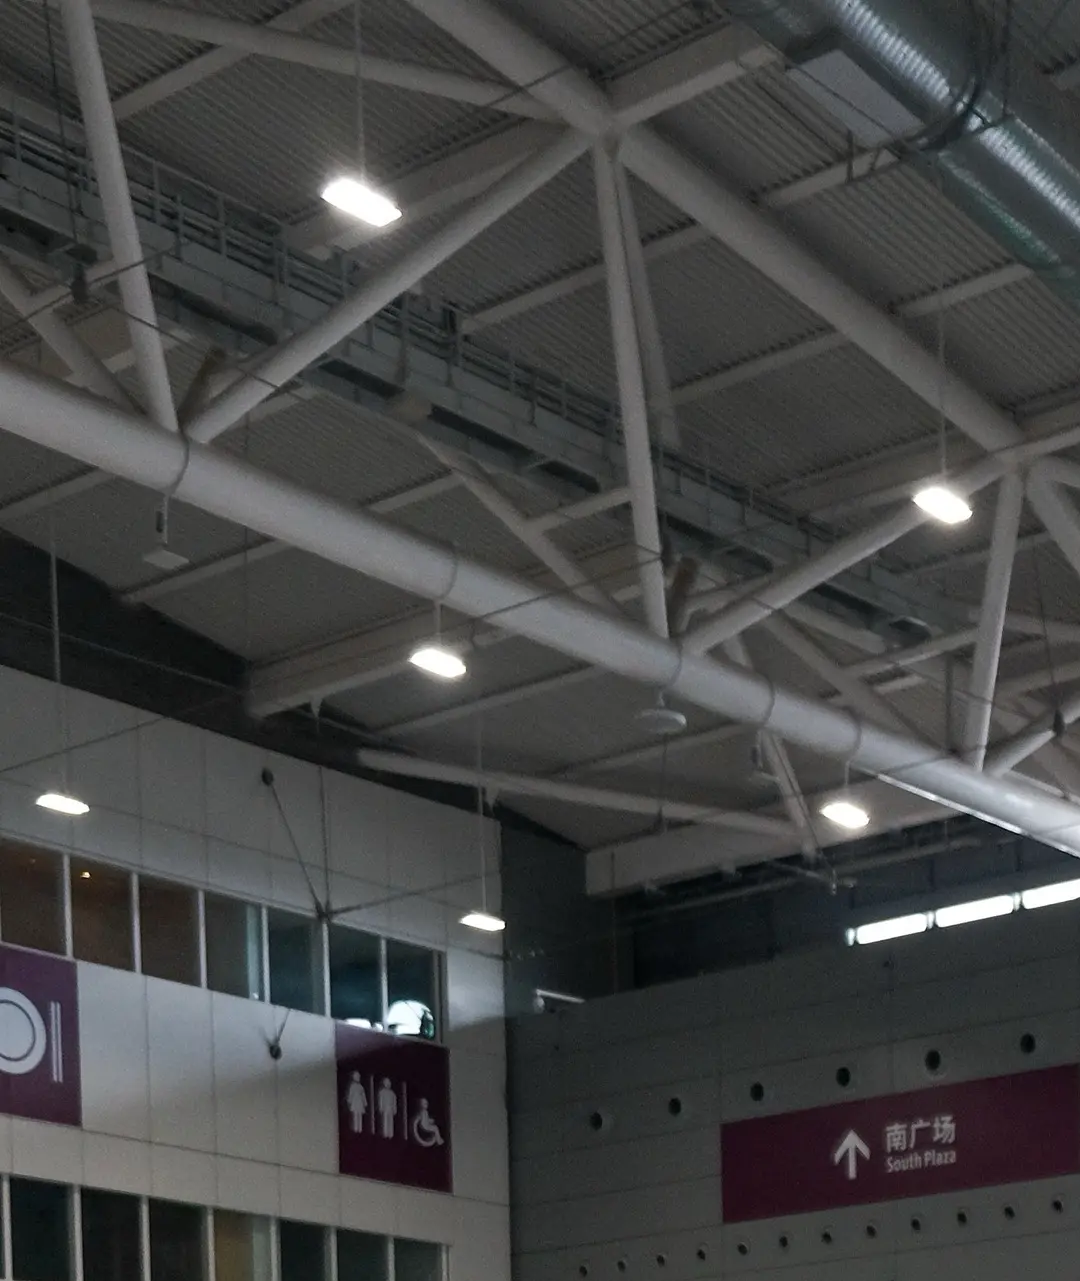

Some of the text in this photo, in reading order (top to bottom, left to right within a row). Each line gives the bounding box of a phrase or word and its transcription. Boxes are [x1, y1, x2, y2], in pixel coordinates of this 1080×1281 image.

[885, 1115, 957, 1154] 南广场
[886, 1149, 957, 1174] South Plaza
